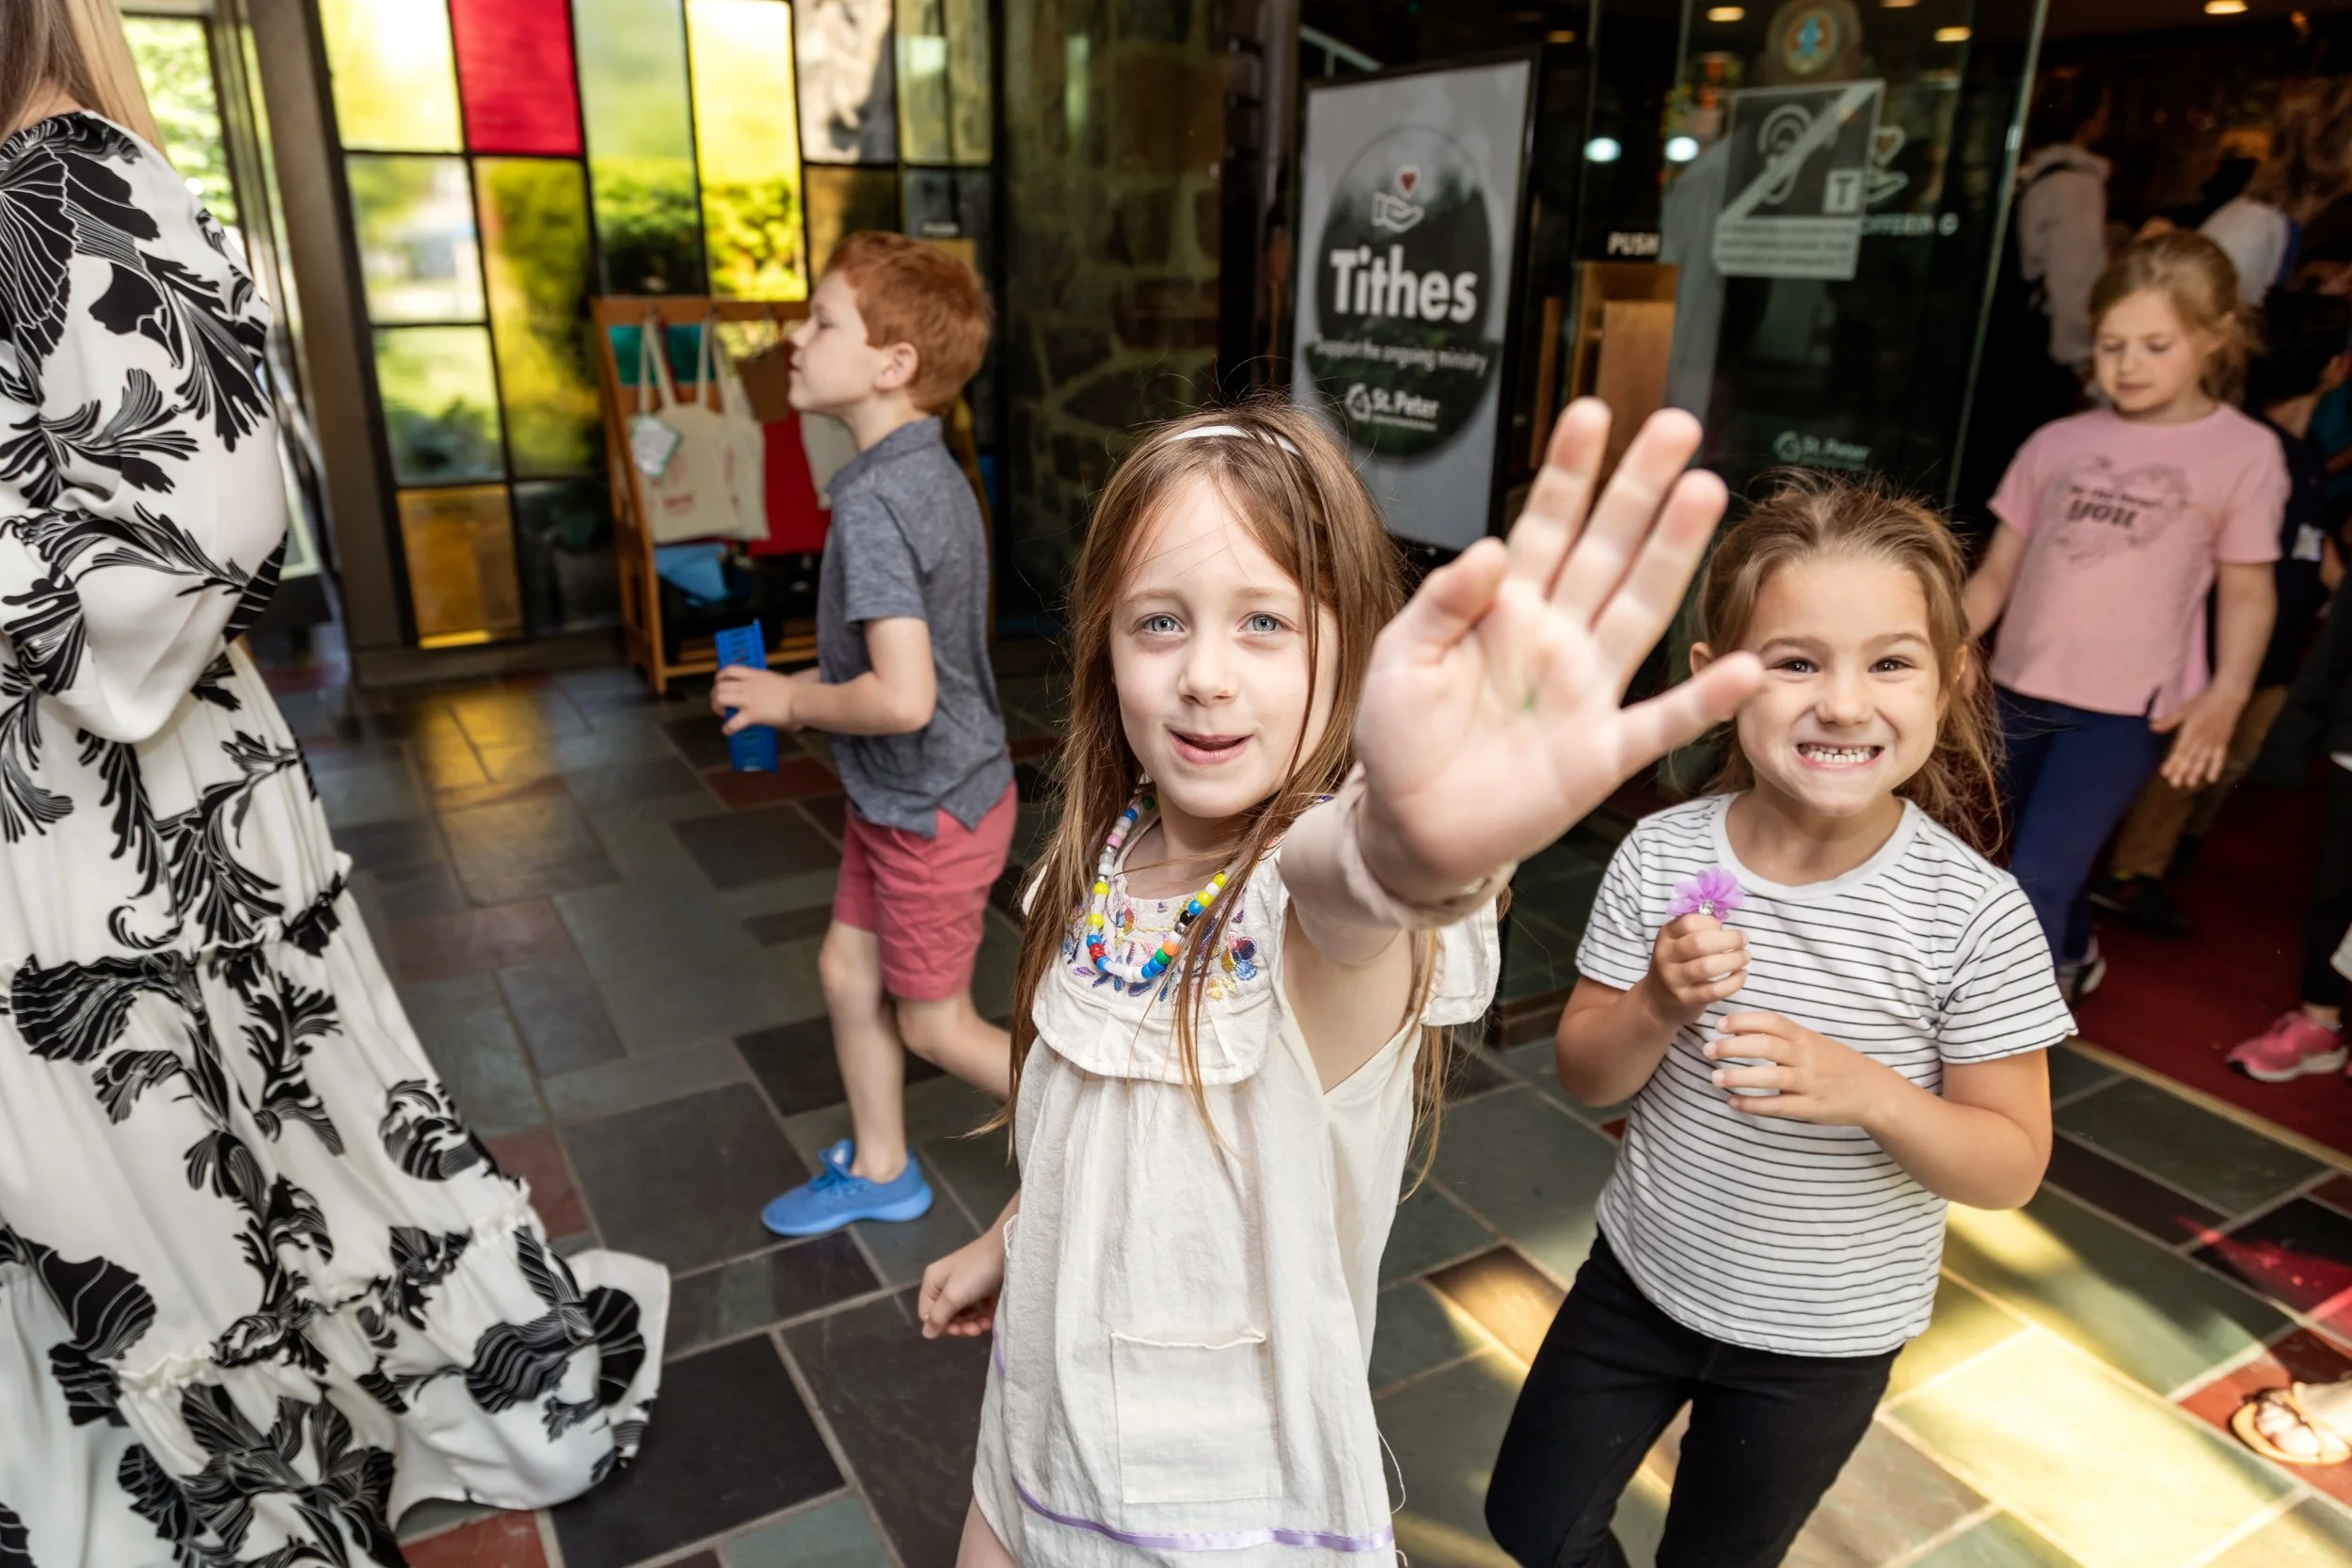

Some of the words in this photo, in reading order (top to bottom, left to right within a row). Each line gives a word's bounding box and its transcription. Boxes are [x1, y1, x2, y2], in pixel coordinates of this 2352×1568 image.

[1835, 176, 1855, 206] T
[1607, 231, 1660, 255] PUSH
[1329, 243, 1478, 324] Tithes
[1383, 343, 1437, 372] ongoing
[1438, 346, 1488, 377] ministry
[1371, 388, 1393, 413] St.
[1394, 389, 1439, 418] Peter
